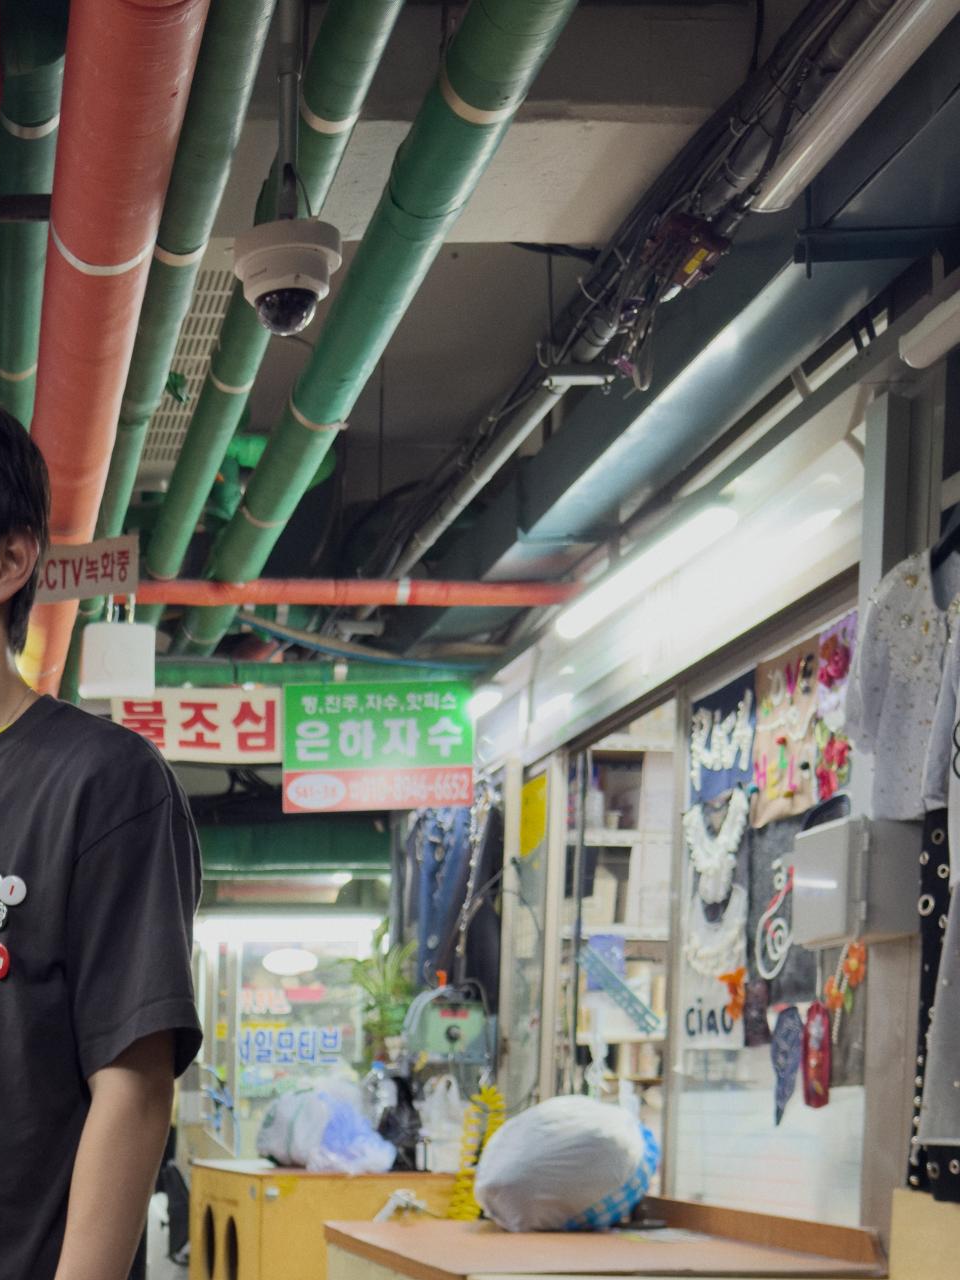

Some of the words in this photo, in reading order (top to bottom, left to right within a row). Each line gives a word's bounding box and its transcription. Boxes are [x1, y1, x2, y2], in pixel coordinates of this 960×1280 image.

[38, 549, 130, 591] CTV녹화중
[122, 700, 276, 752] 불조심
[296, 717, 464, 762] 은하자수
